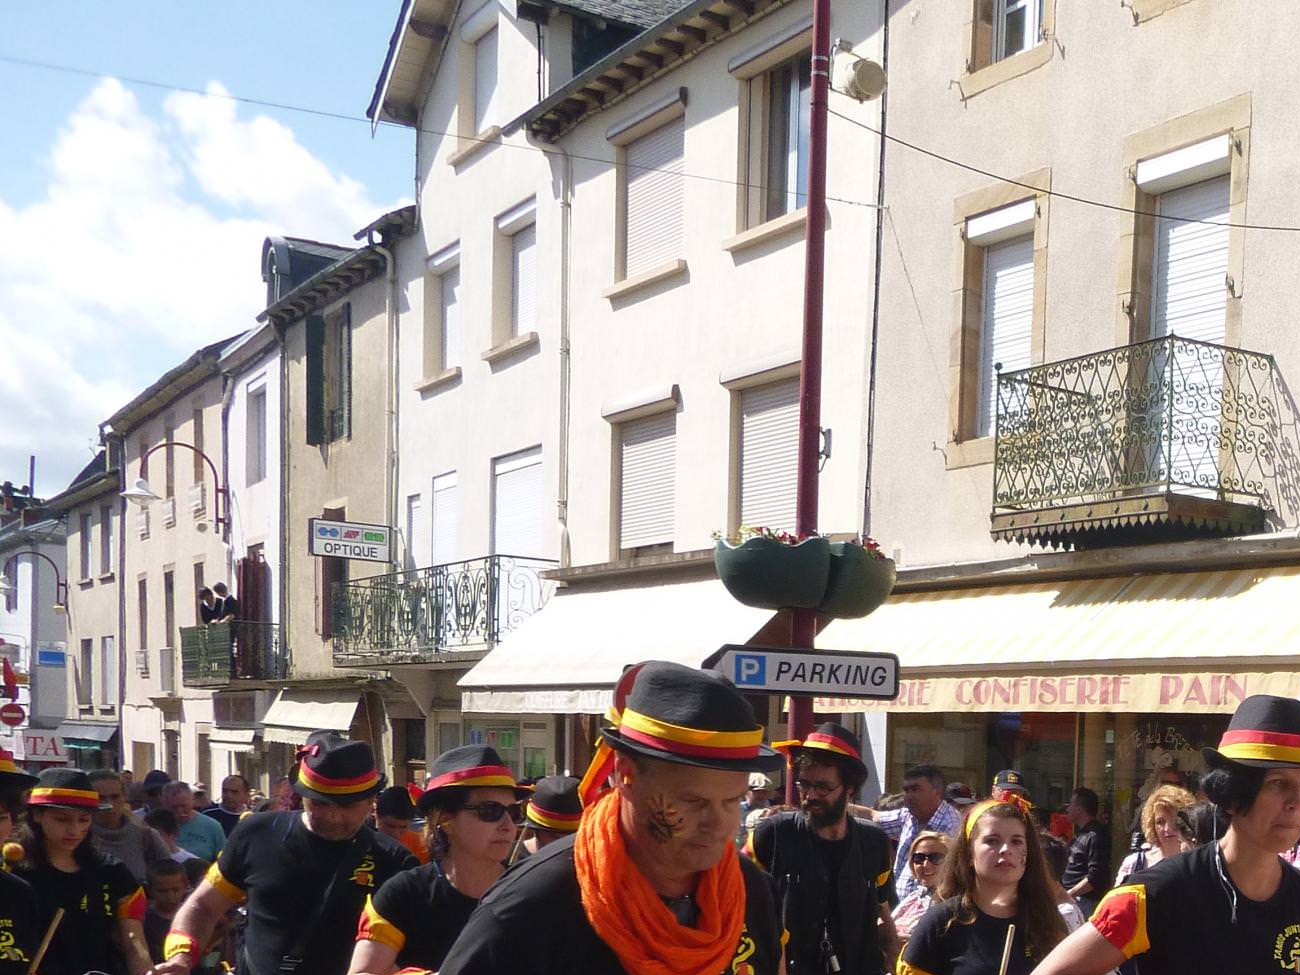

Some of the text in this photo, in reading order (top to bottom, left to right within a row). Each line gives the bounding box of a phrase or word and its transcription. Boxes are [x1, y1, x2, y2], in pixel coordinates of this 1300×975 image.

[323, 542, 379, 559] OPTIQUE
[775, 661, 888, 687] PARKING
[954, 676, 1132, 705] CONFISERIE
[1158, 674, 1249, 706] PAIN
